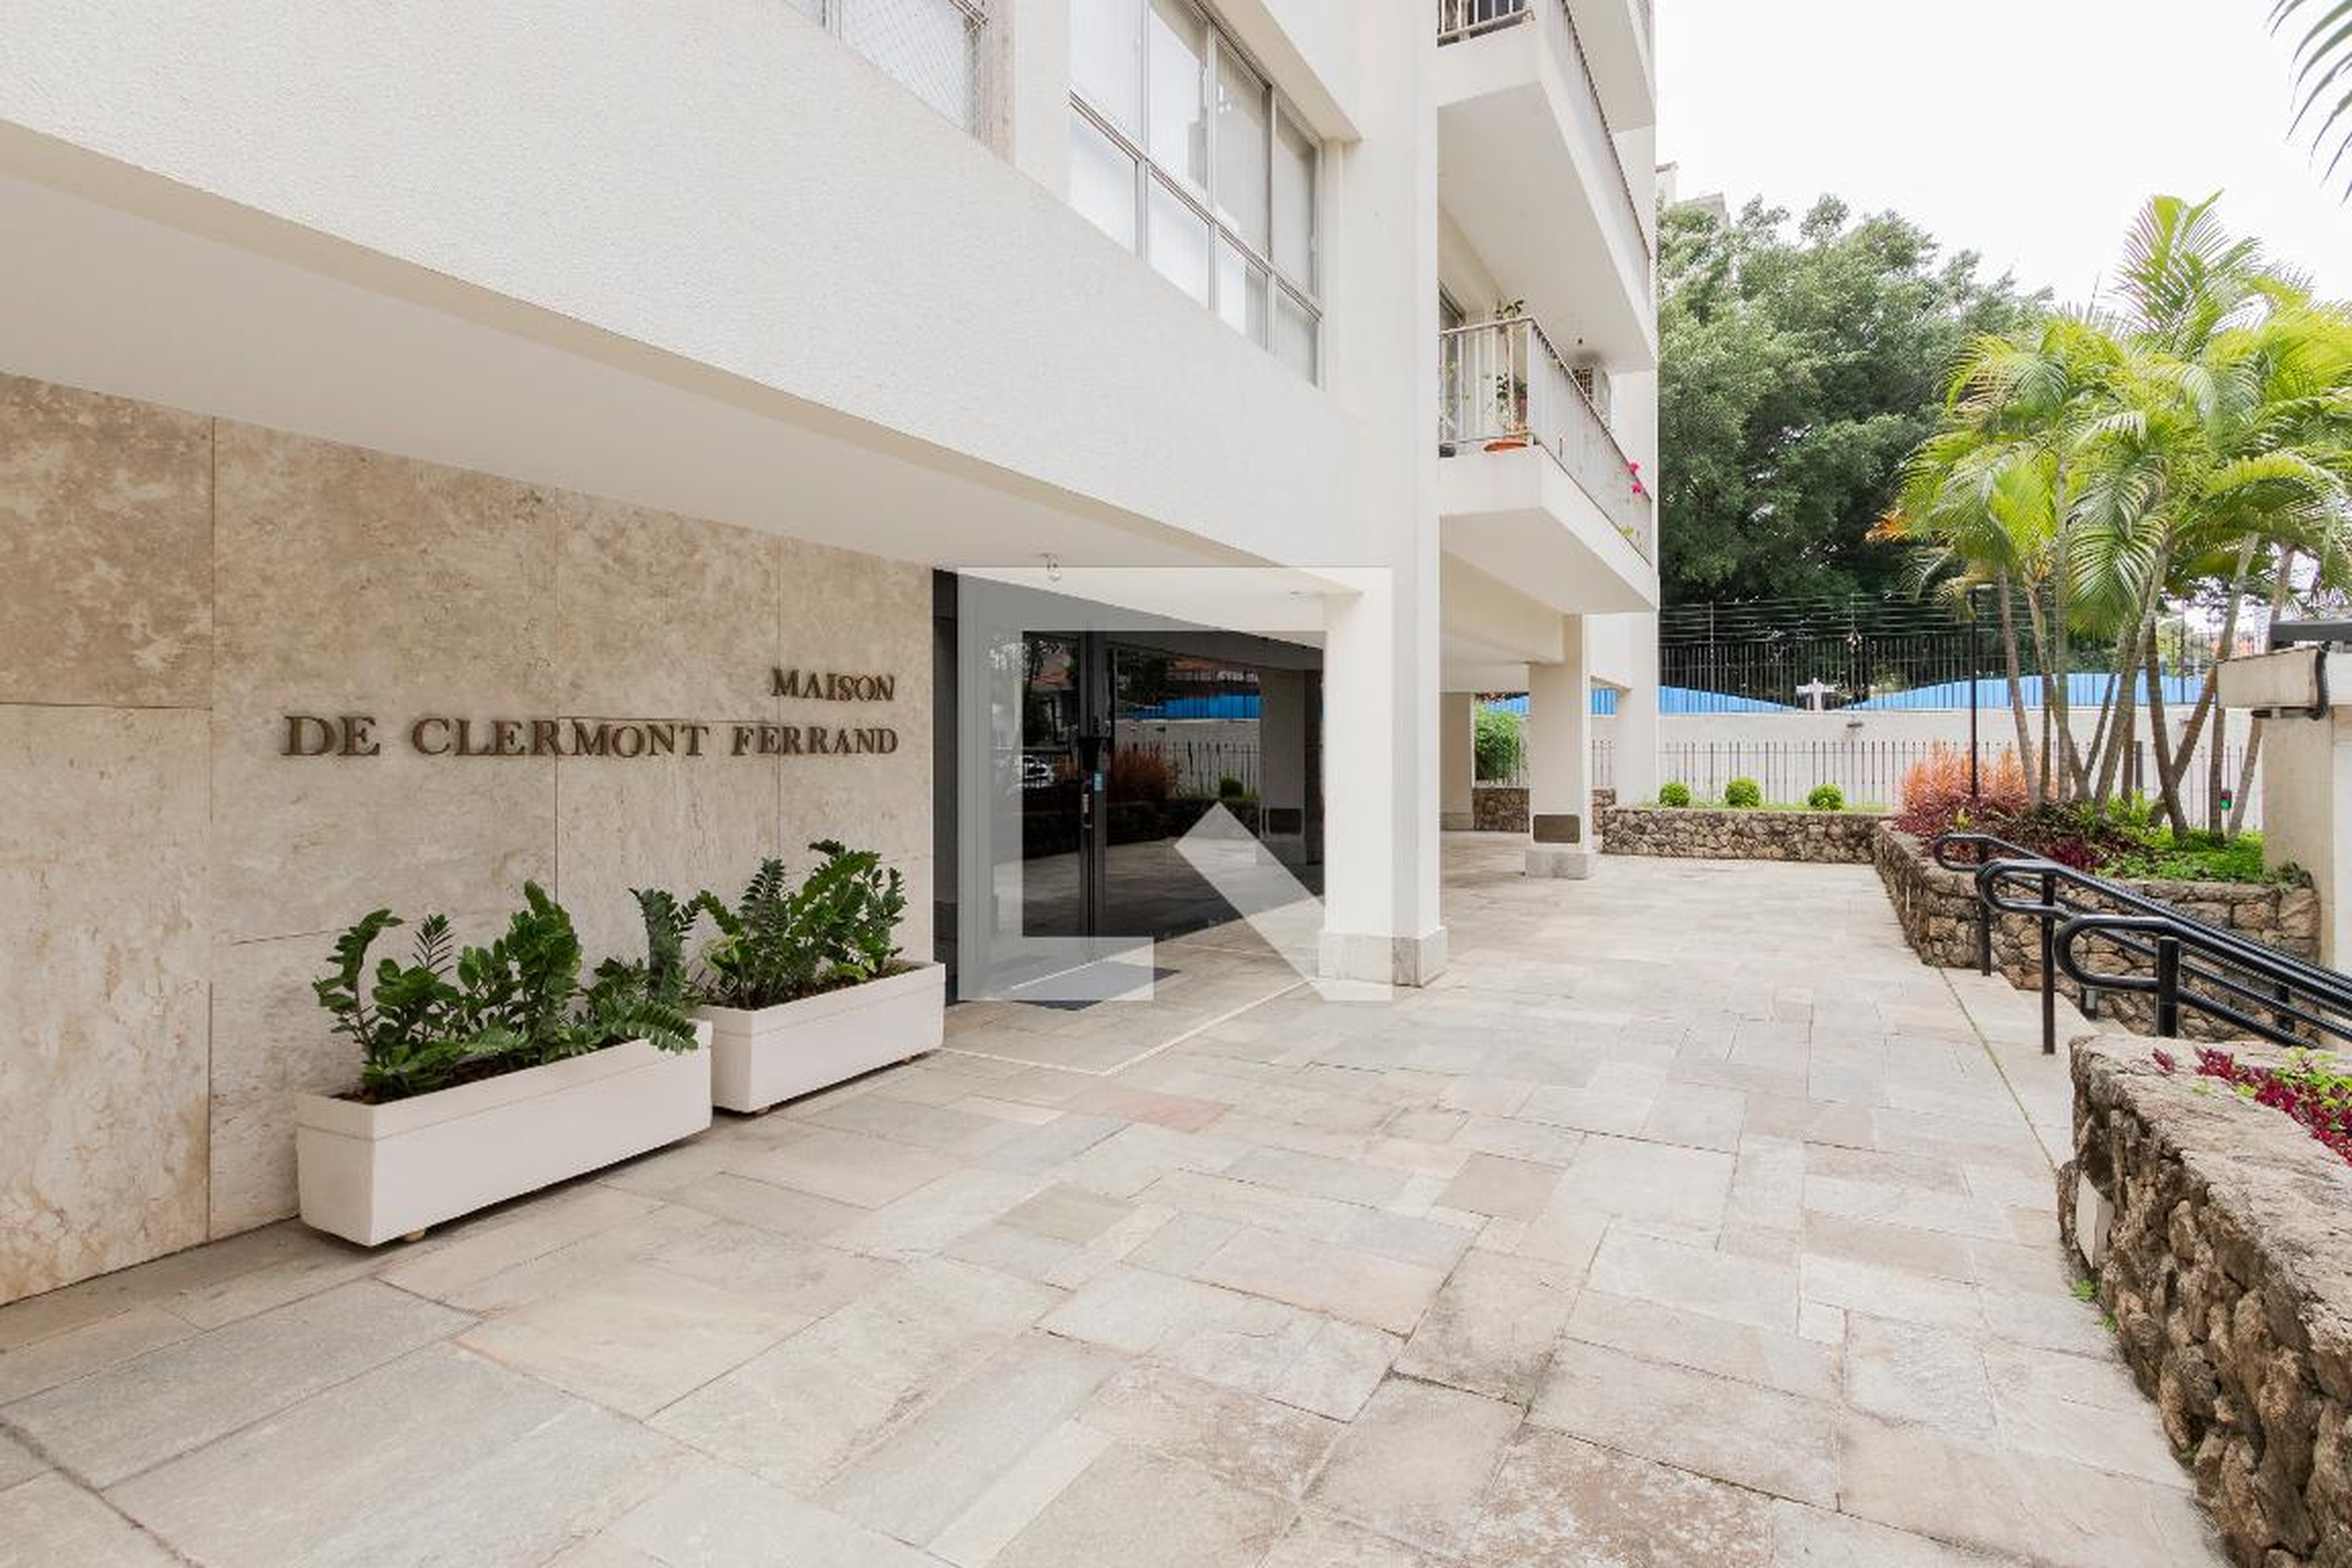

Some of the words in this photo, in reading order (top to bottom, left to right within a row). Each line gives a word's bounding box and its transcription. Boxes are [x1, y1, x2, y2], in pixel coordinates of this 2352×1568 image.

[770, 667, 895, 701] MAISON
[281, 715, 380, 756] DE
[412, 717, 709, 758] CLERMONT
[731, 726, 899, 756] FERRAND
